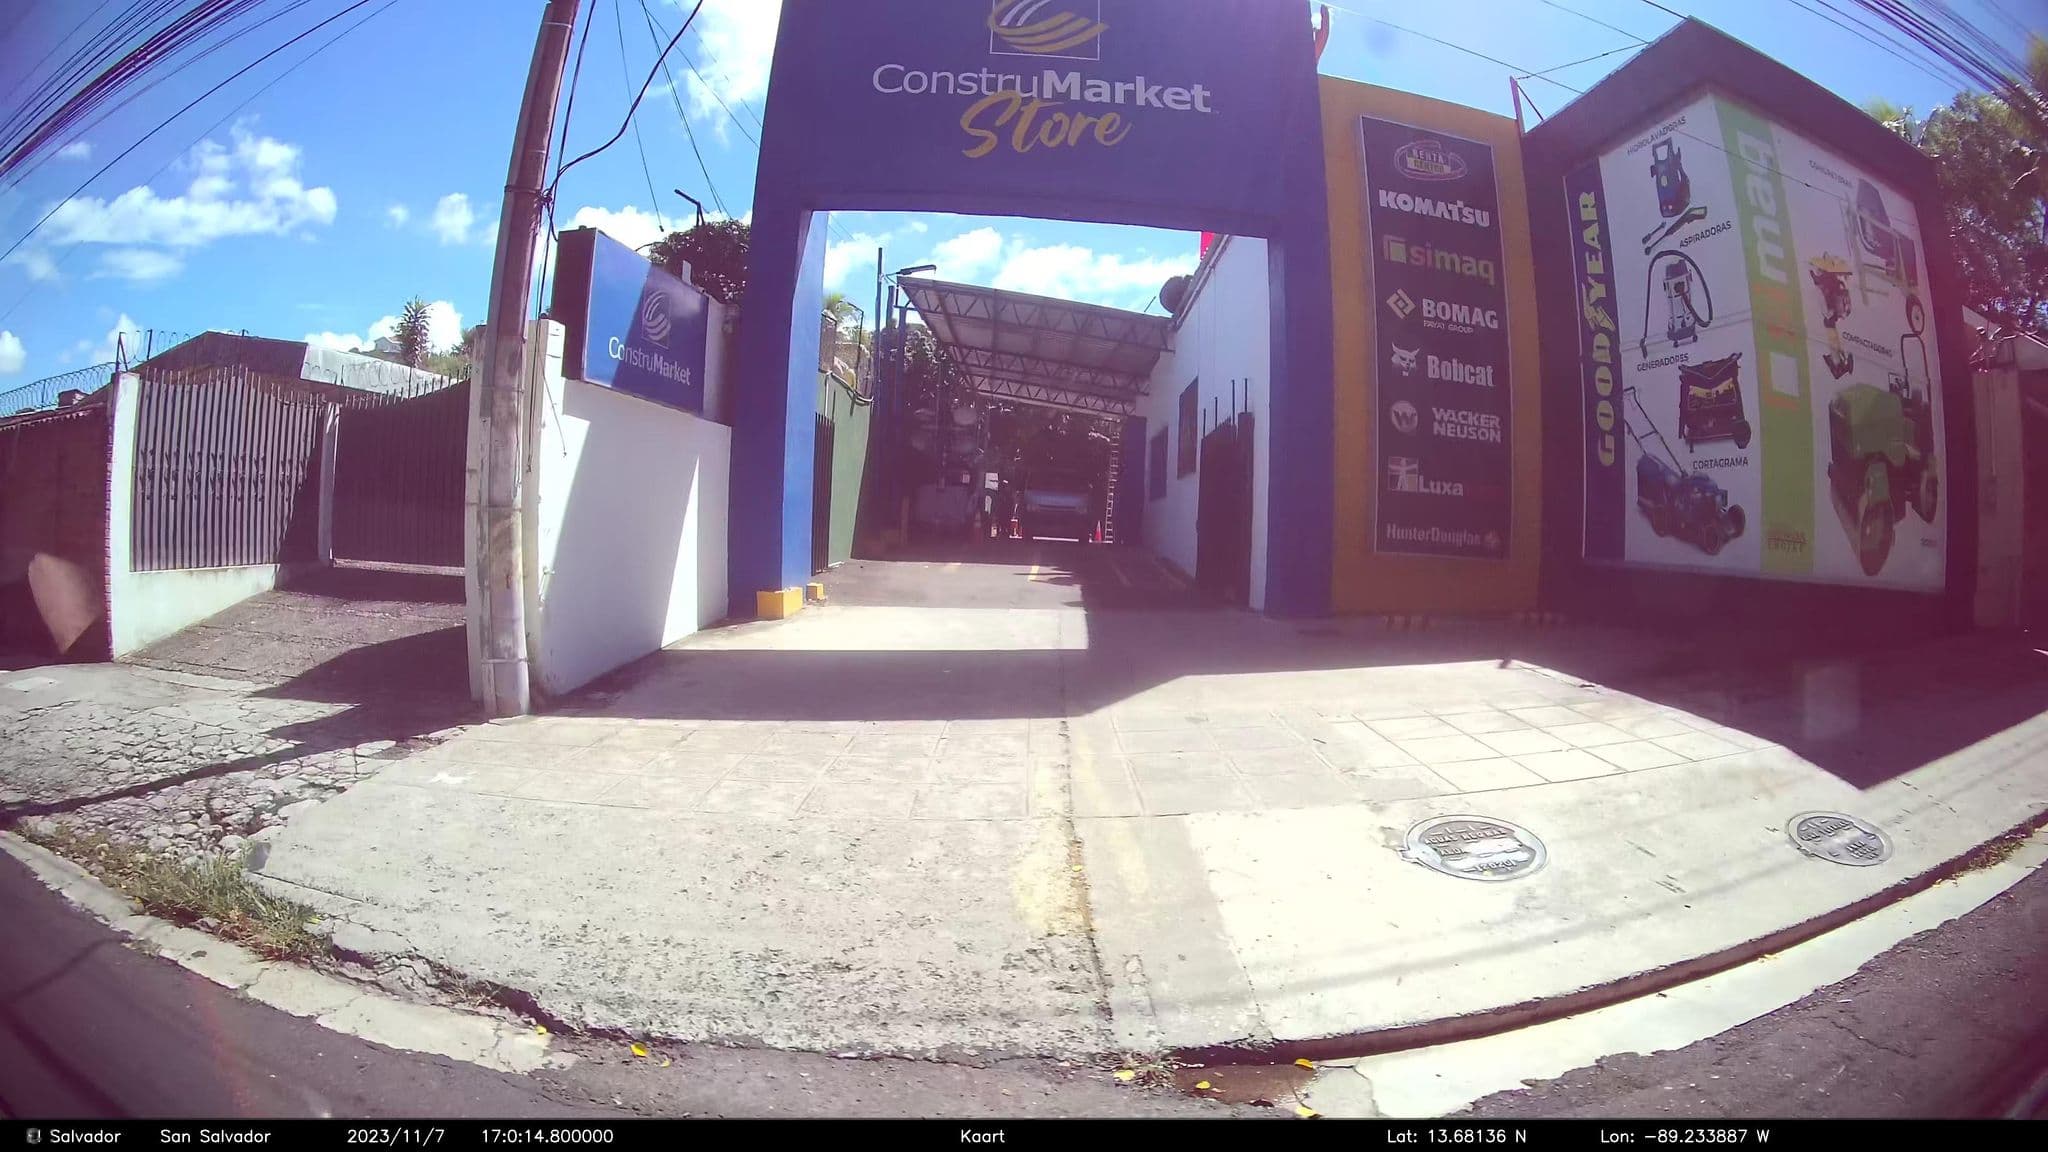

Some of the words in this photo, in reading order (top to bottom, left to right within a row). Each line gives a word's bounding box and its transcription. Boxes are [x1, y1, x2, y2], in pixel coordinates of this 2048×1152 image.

[872, 63, 1212, 113] ConstruMarket
[959, 89, 1133, 159] Store
[1379, 189, 1490, 228] KOMATSU
[1679, 220, 1732, 249] ASPIRADORAS
[1410, 241, 1496, 286] simaq
[1422, 298, 1499, 329] BOMAG
[1578, 191, 1616, 467] GOODYEAR
[609, 336, 691, 386] ConstruMarket
[1427, 355, 1495, 387] Bobcat
[1636, 352, 1689, 372] GENERADORES
[1432, 407, 1501, 429] WACKER
[1432, 422, 1502, 443] NEUSON
[1692, 456, 1749, 470] CORTAGRAMA
